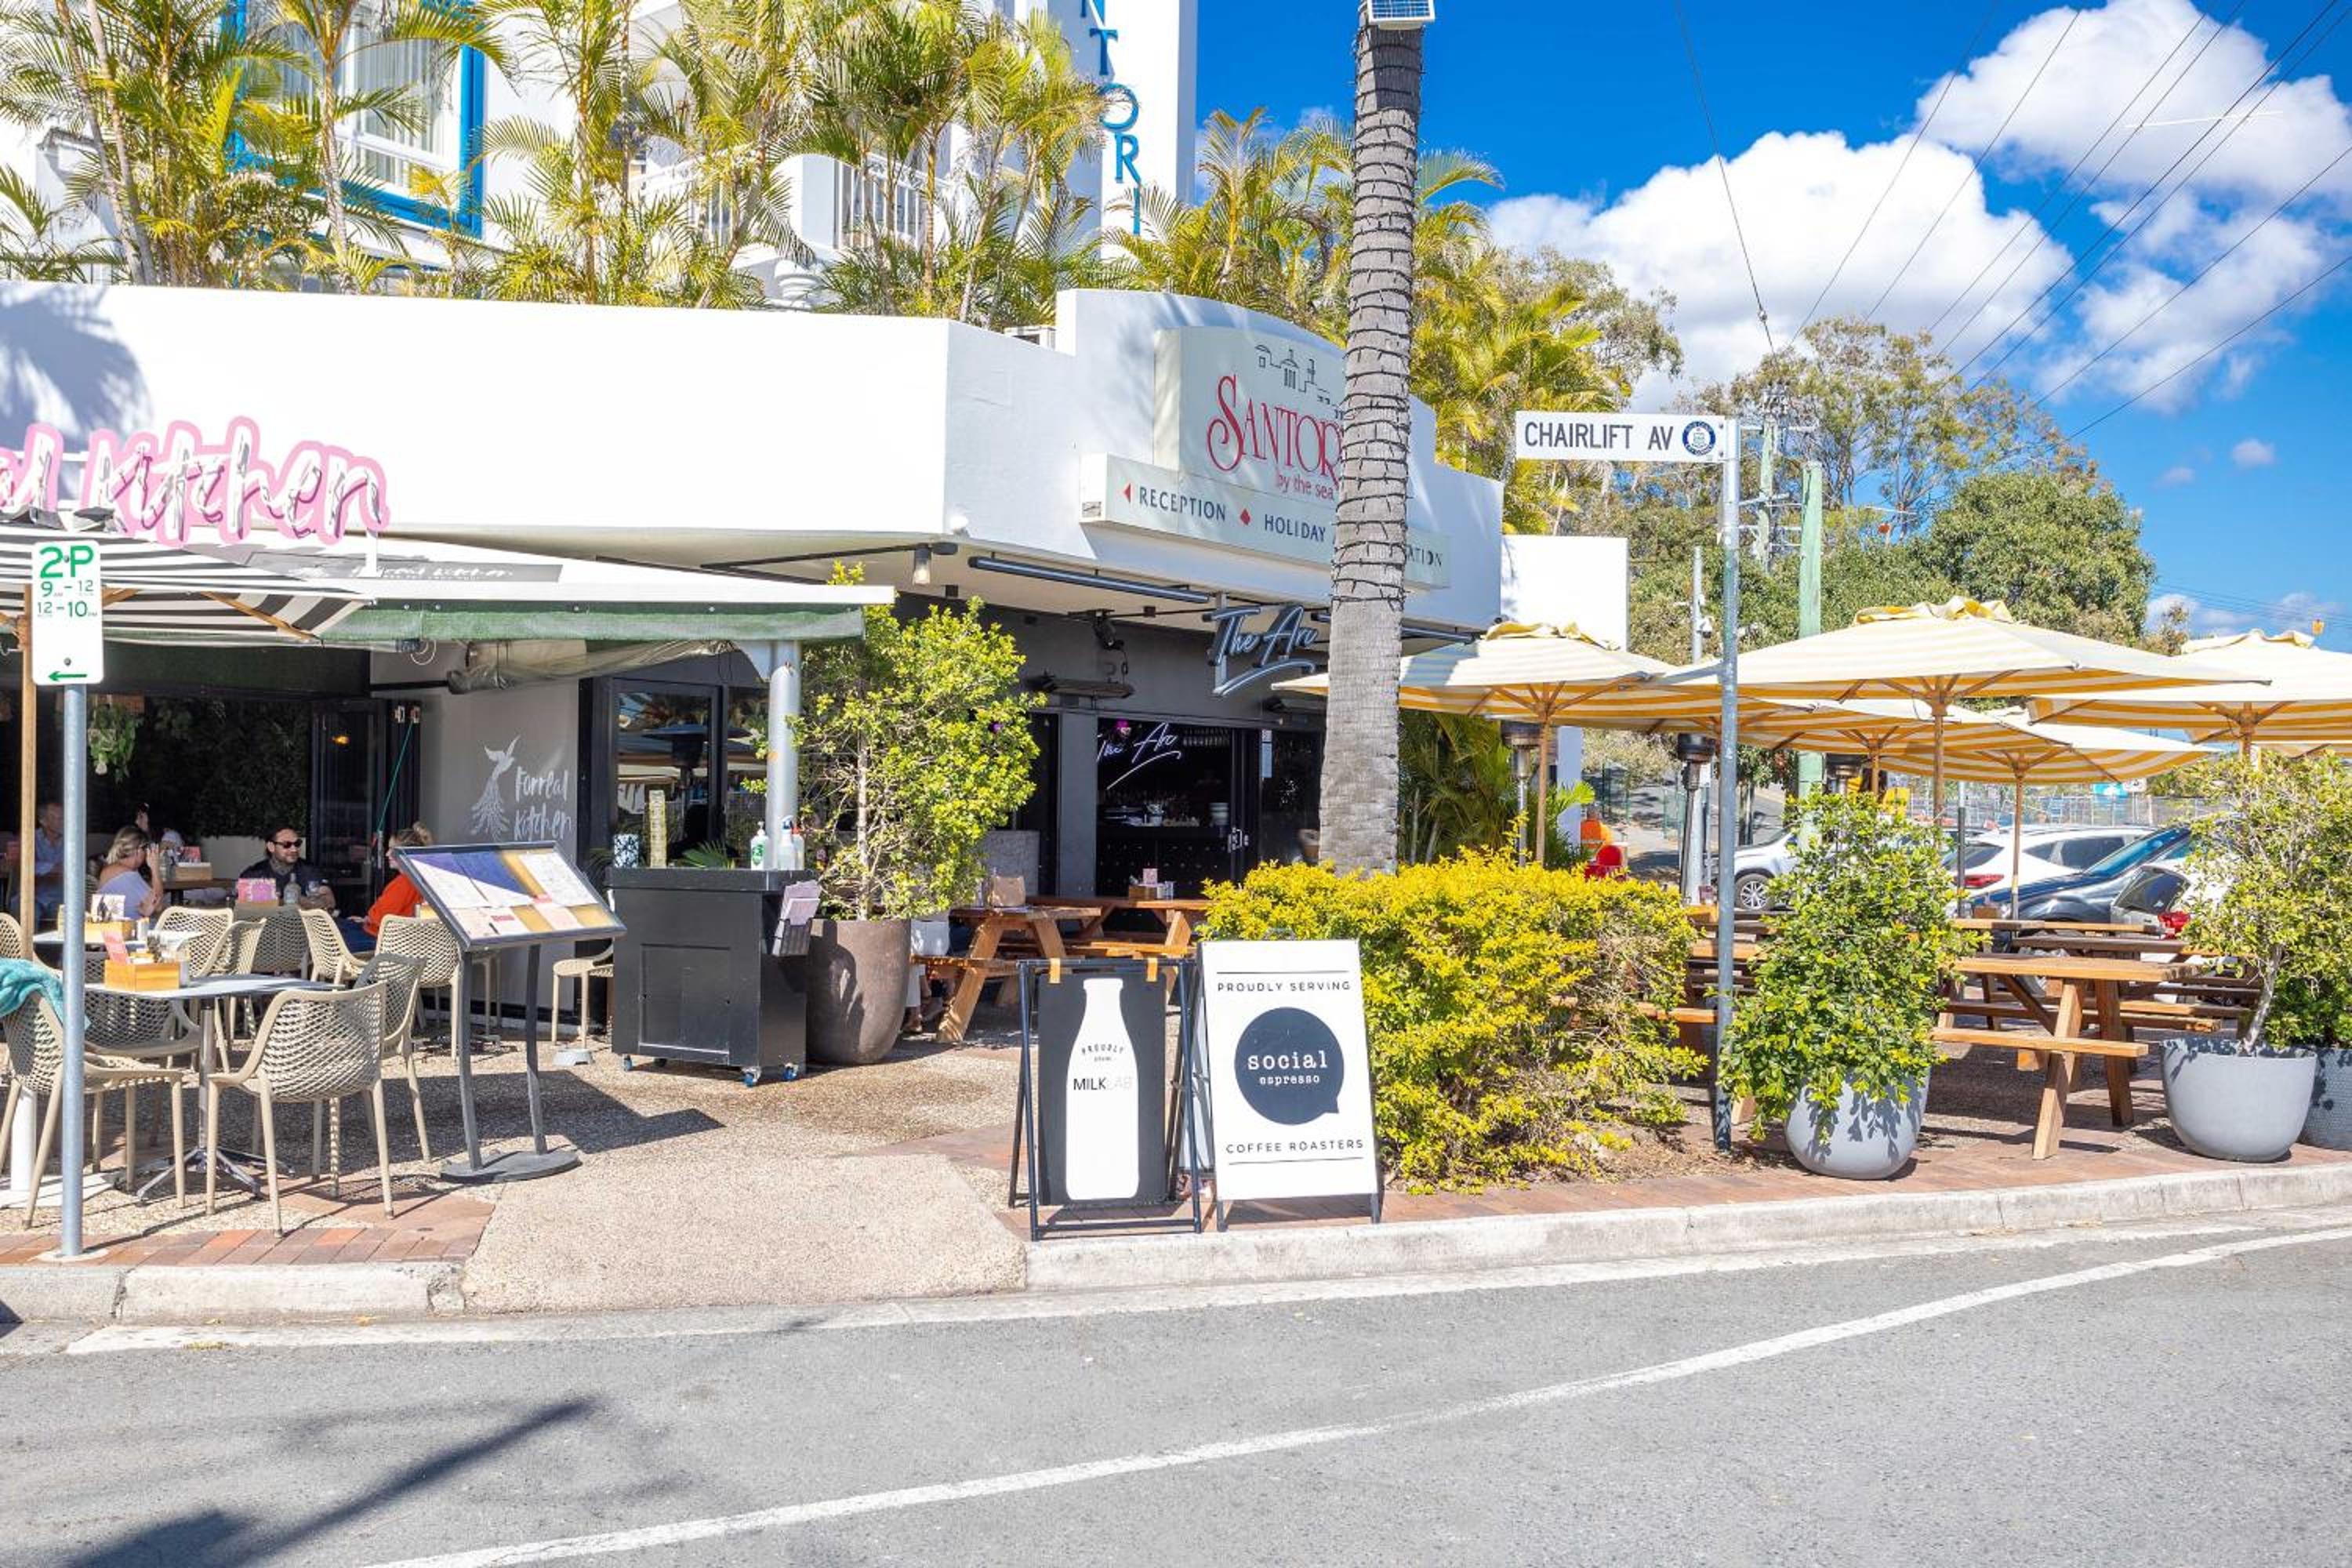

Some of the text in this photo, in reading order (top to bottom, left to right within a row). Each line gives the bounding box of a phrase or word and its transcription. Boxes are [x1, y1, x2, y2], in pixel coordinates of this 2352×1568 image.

[1207, 374, 1343, 492] SANTOR
[1525, 422, 1633, 449] CHAIRLIFT
[1648, 426, 1674, 451] AV
[1279, 474, 1334, 500] by the sea
[1139, 486, 1443, 567] RECEPTION HOLIDAY ATION
[40, 546, 93, 577] 2P
[1203, 605, 1261, 666] The
[1218, 981, 1351, 992] PROUDLY SERVING
[1247, 1051, 1327, 1070] social
[1259, 1075, 1319, 1086] espresso
[1226, 1139, 1363, 1153] COFFEE ROASTERS
